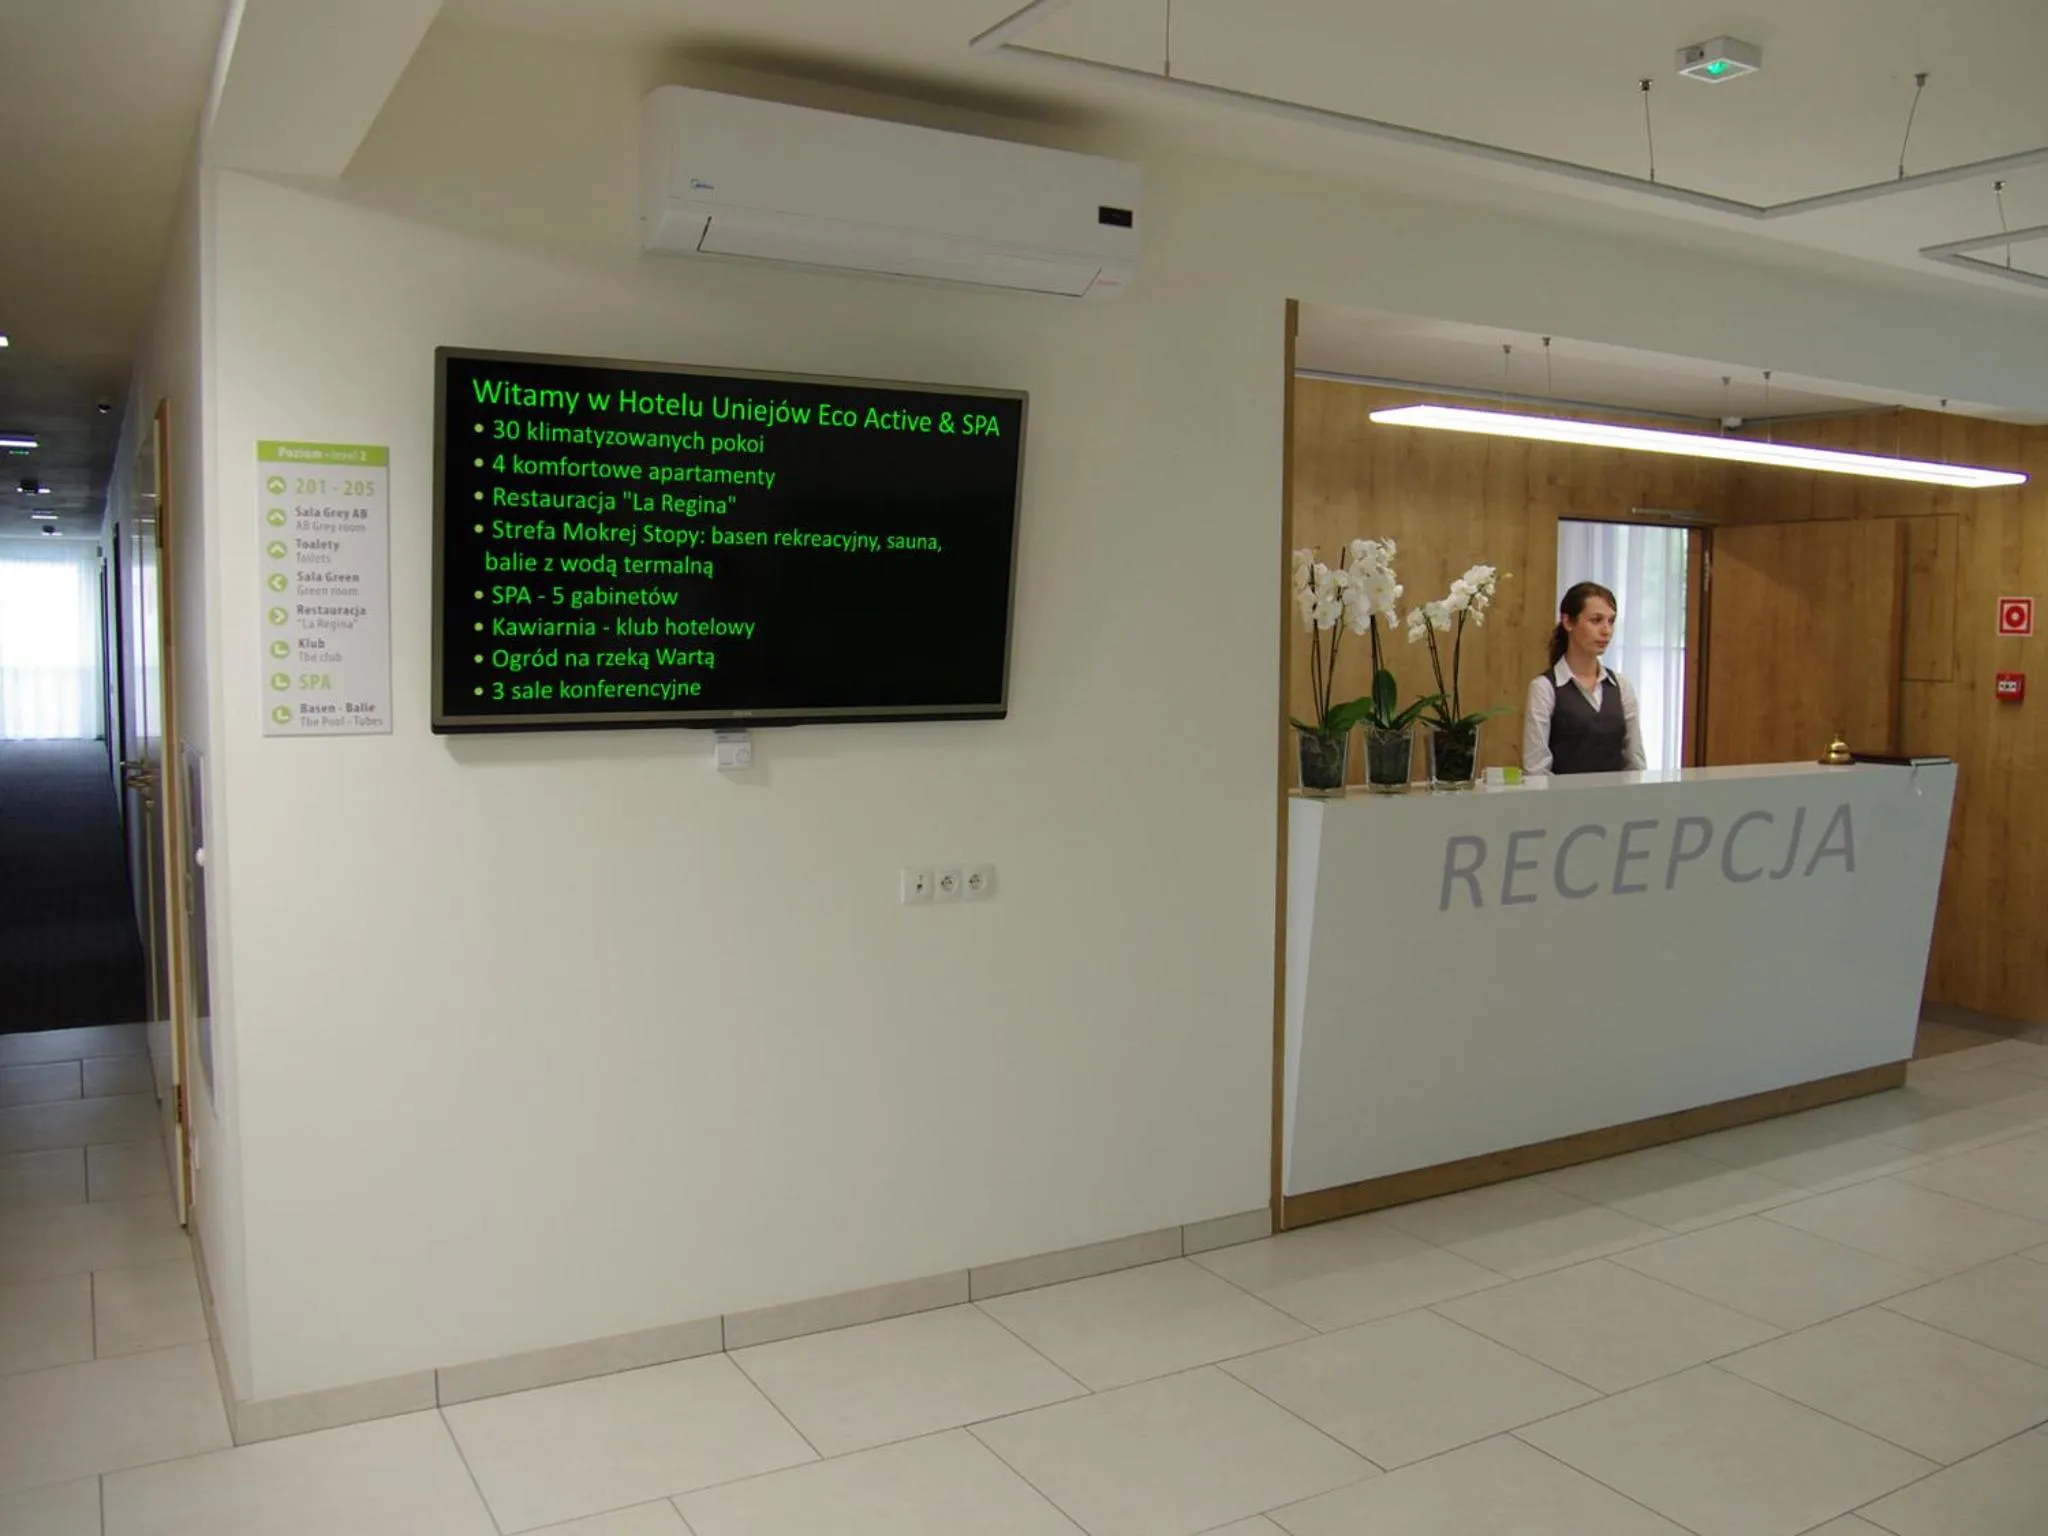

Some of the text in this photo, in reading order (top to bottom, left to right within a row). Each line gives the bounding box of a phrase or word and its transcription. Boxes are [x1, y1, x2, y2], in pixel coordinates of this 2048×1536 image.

[471, 378, 1000, 436] Witamy w Hotelu Uniejów Eco Active & SPA
[492, 419, 765, 454] 30 klimatyzowanych pokoi
[492, 455, 776, 491] 4 komfortowe apartamenty
[295, 478, 326, 495] 201
[343, 480, 375, 497] 205
[295, 506, 368, 520] Sala Grey AB
[492, 487, 736, 518] Restauracja "La Regina"
[295, 539, 339, 551] Toalety
[492, 519, 943, 553] Strefa Mokrej Stopy: basen rekreacyjny, sauna,
[297, 571, 359, 582] Sala Green
[484, 551, 714, 579] balie z wodą termalną
[491, 586, 532, 605] SPA
[552, 585, 565, 605] 5
[570, 587, 679, 609] gabinetów
[297, 605, 366, 617] Restauracja
[492, 617, 597, 637] Kawiarnia
[615, 616, 659, 637] klub
[664, 619, 756, 640] hotelowy
[299, 639, 325, 649] Klub
[491, 647, 716, 674] Ogród na rzeką Wartą
[300, 674, 331, 690] SPA
[492, 679, 702, 701] 3 sale konferencyjne
[300, 703, 336, 714] Basen
[345, 703, 375, 713] Balie
[1438, 803, 1857, 912] RECEPCJA
